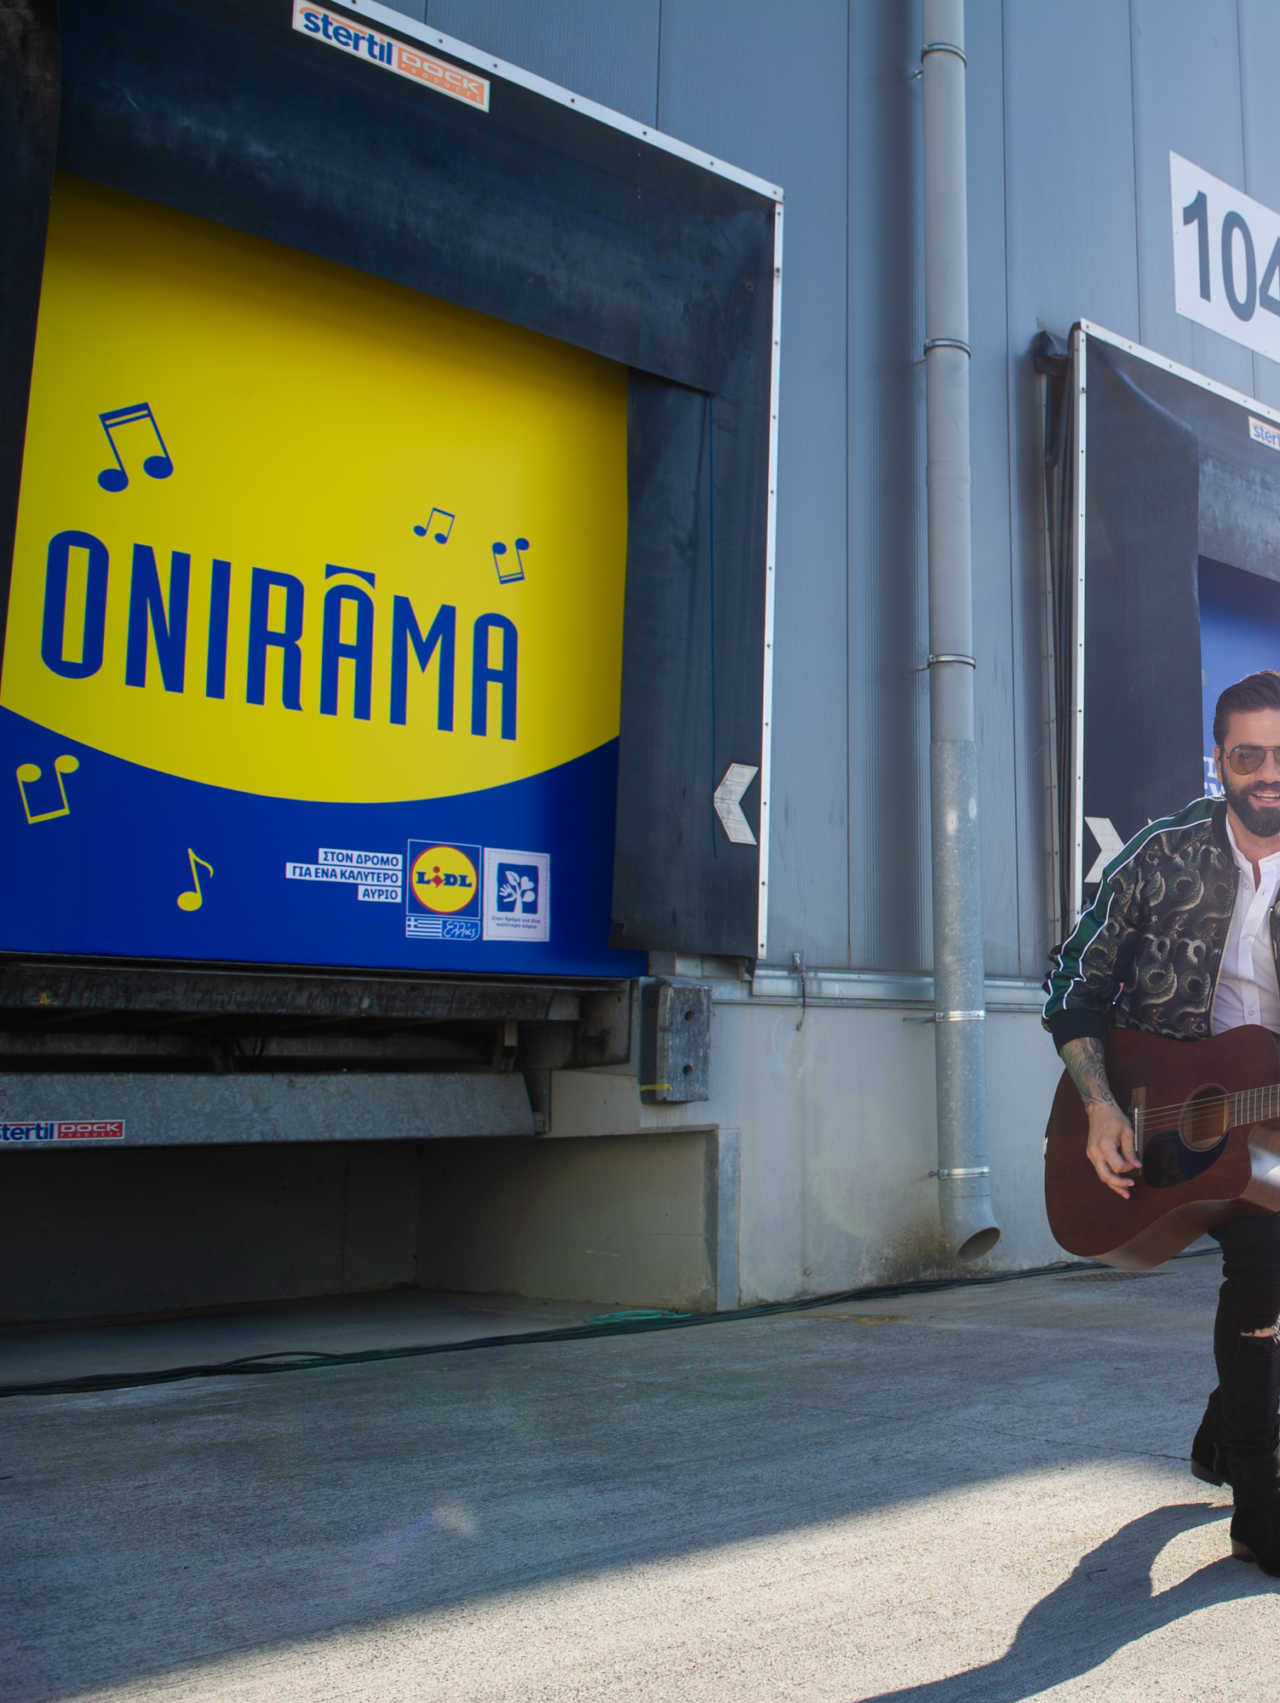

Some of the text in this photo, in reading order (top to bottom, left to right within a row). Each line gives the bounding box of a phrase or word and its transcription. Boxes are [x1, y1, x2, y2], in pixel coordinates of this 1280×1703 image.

[303, 11, 393, 66] stertil
[402, 52, 480, 95] DOCK
[323, 850, 399, 867] ΣΤΟΝ ΔΡΟΜΟ
[292, 865, 399, 884] ΓΙΑ ΕΝΑ ΚΑΛΥΤΕΡΟ
[362, 887, 398, 901] ΑΥΡΙΟ
[0, 1122, 54, 1140] tertil
[60, 1123, 121, 1133] DOCK
